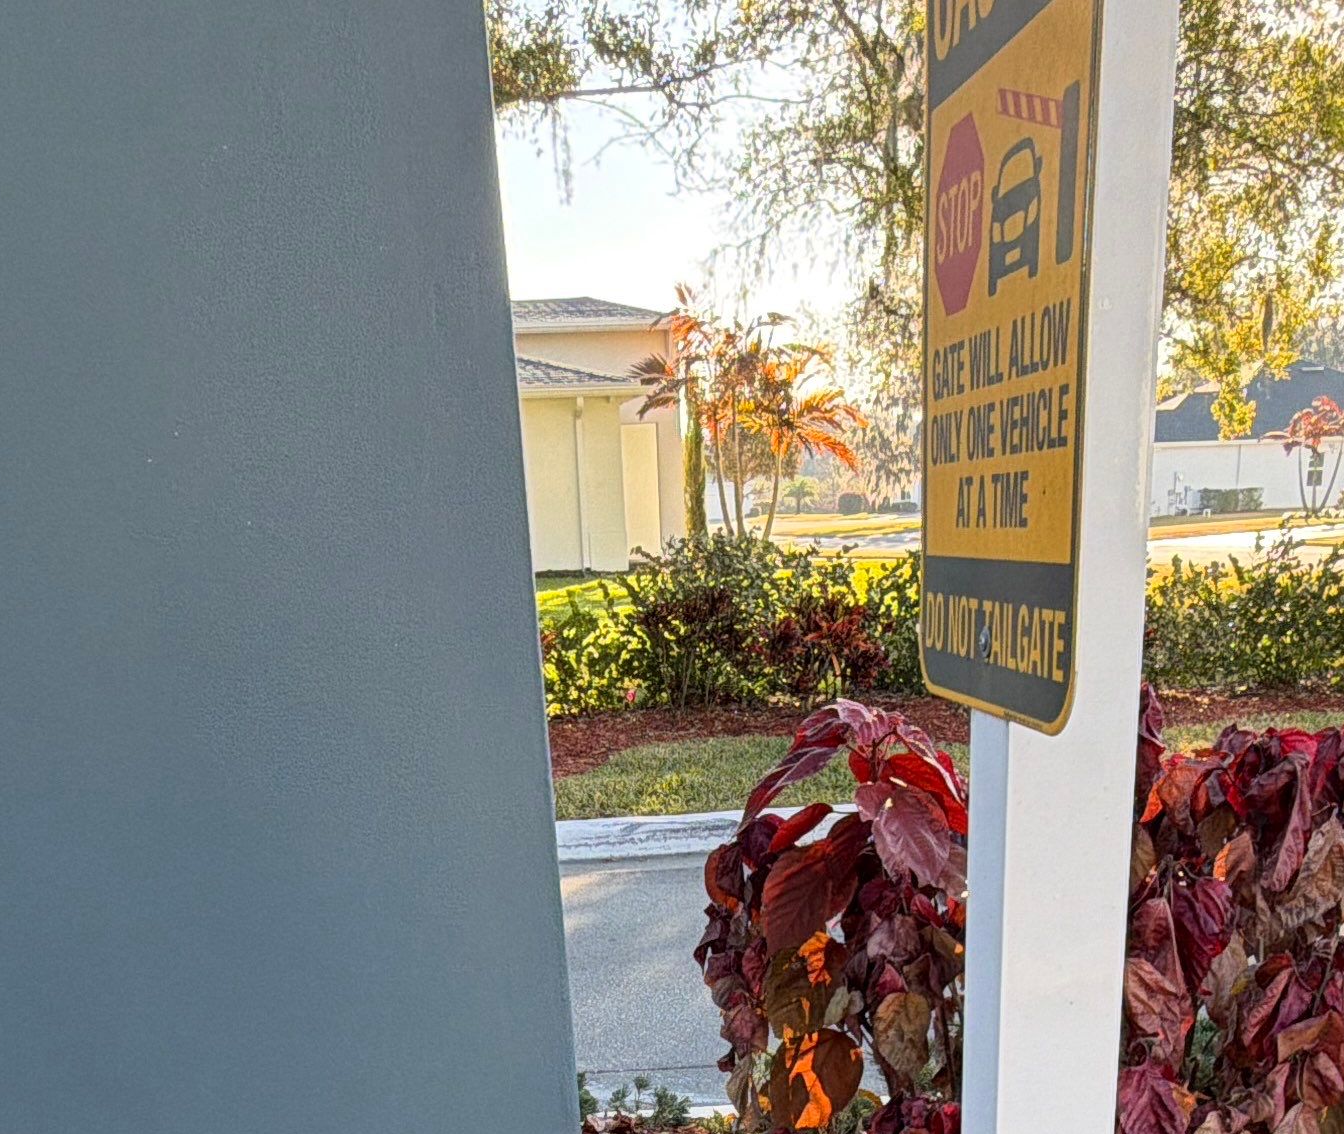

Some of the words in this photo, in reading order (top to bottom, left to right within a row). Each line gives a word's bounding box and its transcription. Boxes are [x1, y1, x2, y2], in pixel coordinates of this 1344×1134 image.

[936, 170, 982, 265] STOP
[932, 340, 965, 402] GATE
[968, 326, 1004, 391] WILL
[1008, 298, 1071, 380] ALLOW
[931, 410, 963, 466] ONLY
[967, 402, 995, 461] ONE
[1000, 383, 1069, 456] VEHICLE
[956, 476, 974, 528] AT
[976, 475, 987, 528] A
[992, 470, 1029, 529] TIME
[926, 592, 944, 651] DO
[947, 595, 978, 659] NOT
[983, 600, 1066, 683] TAILGATE
